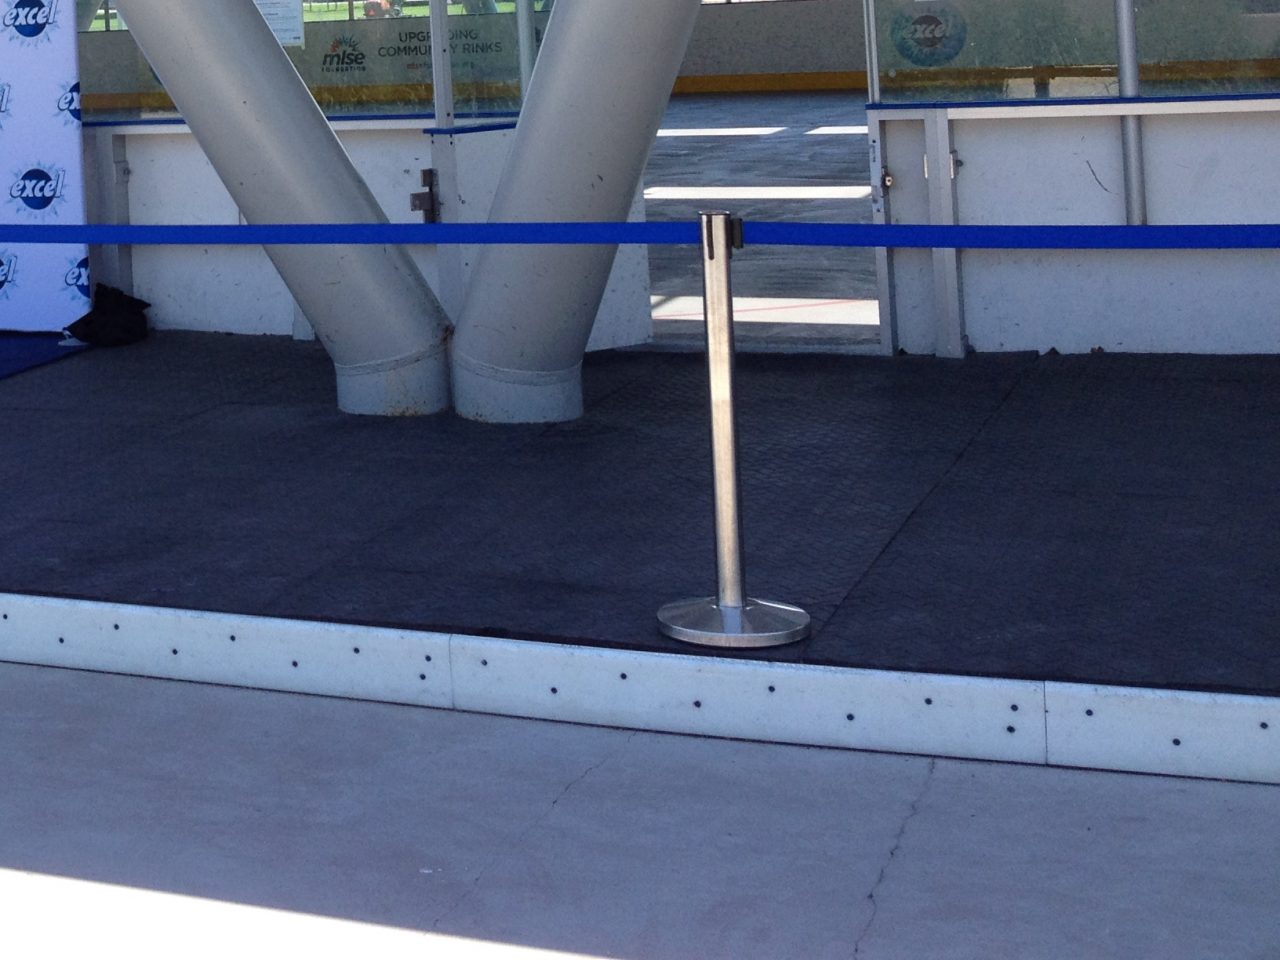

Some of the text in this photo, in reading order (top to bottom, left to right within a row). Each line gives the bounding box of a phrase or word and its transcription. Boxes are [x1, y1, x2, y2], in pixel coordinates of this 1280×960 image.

[462, 42, 502, 54] RINKS
[323, 50, 366, 65] mlse
[10, 170, 65, 201] excel
